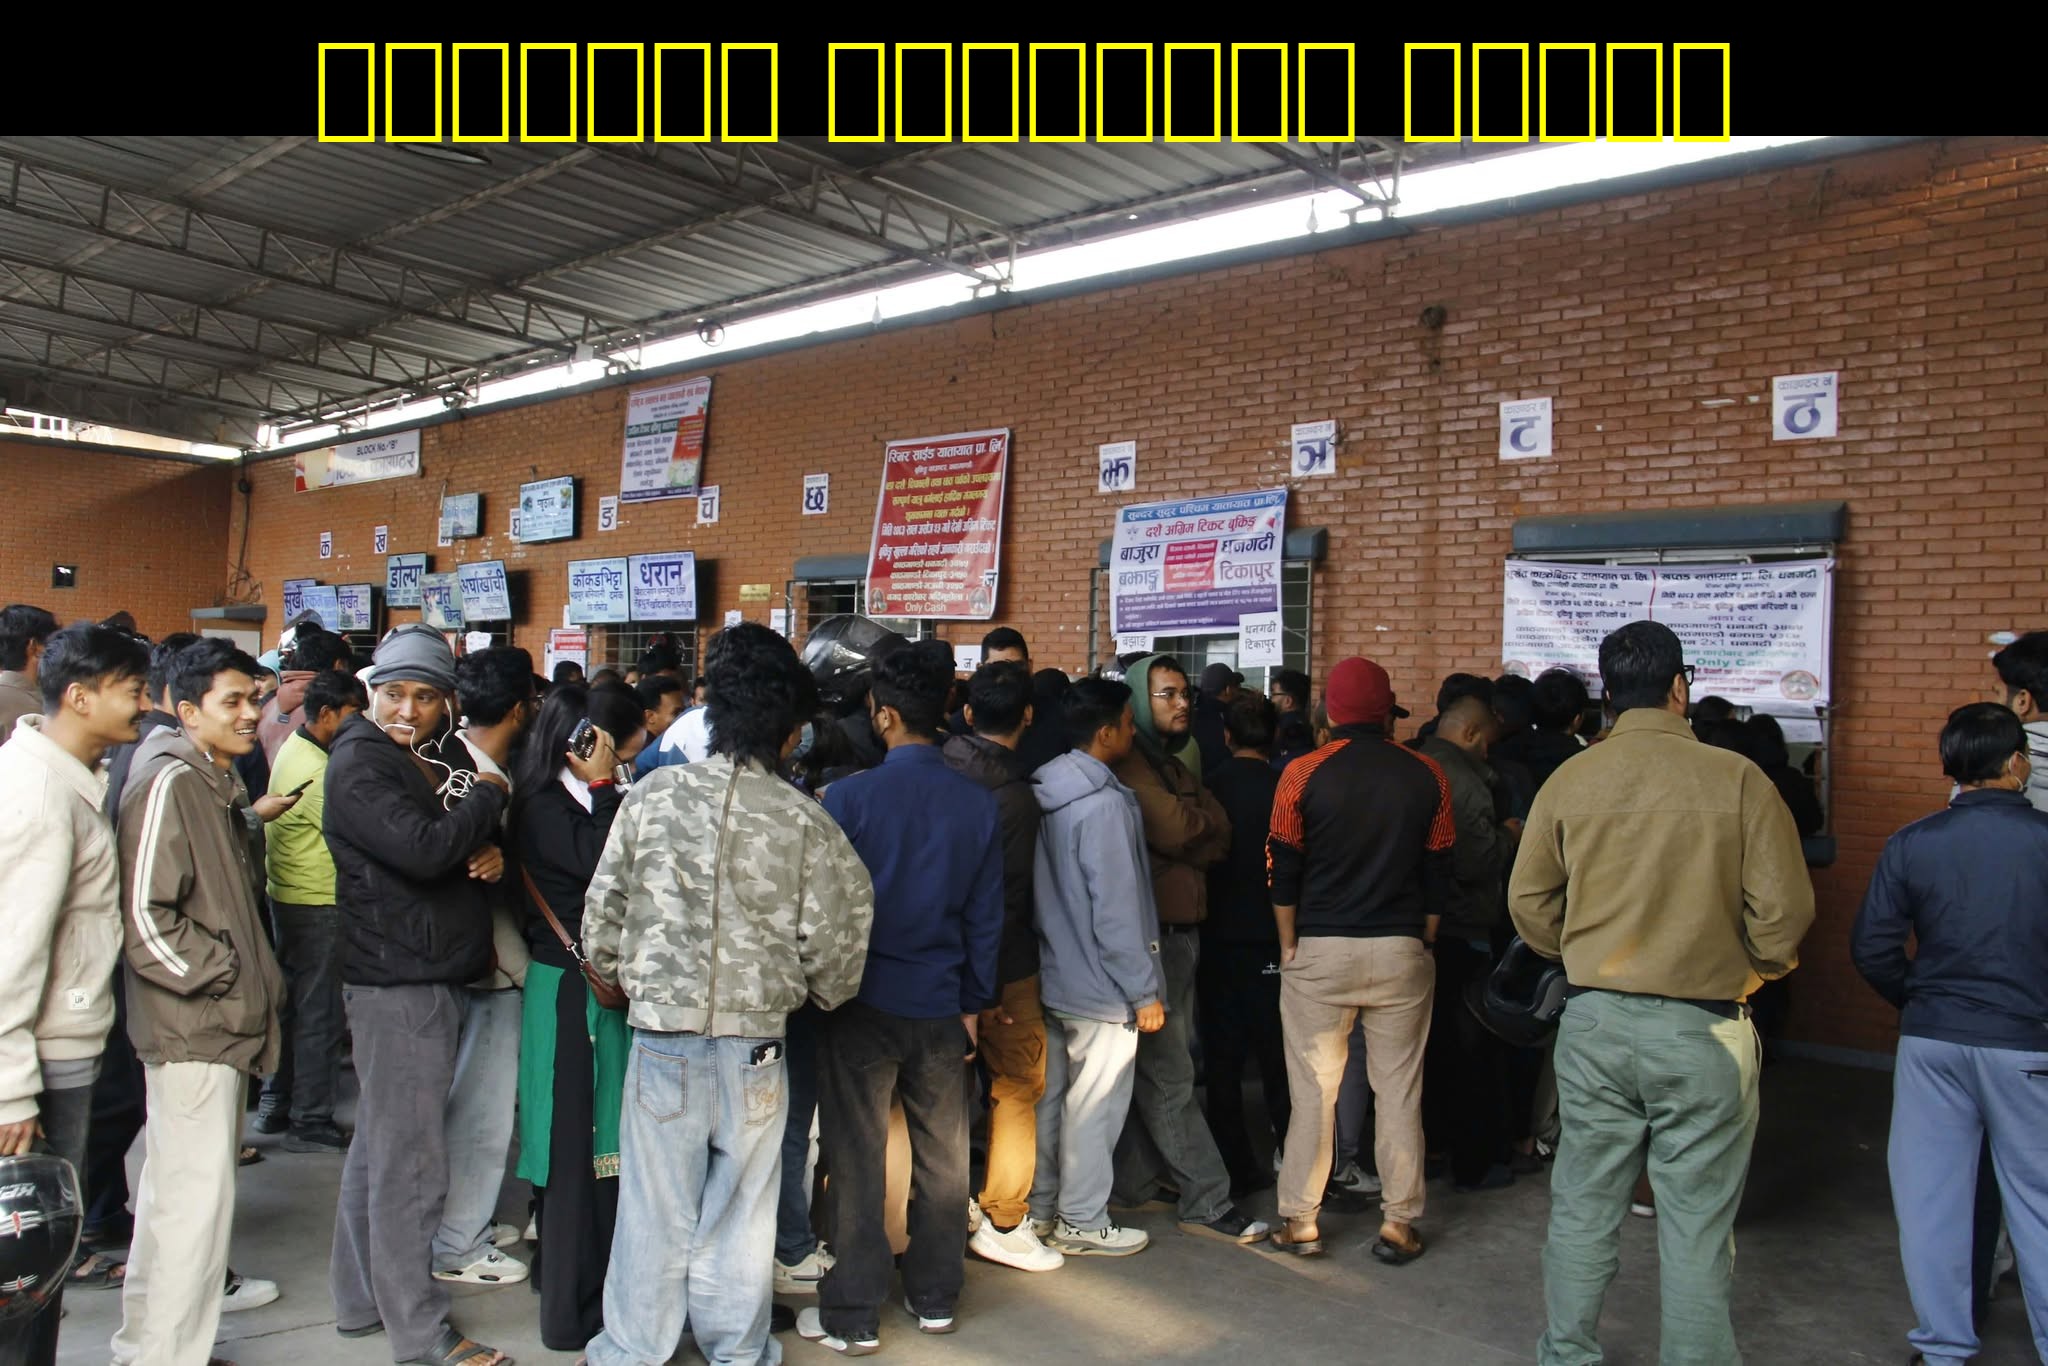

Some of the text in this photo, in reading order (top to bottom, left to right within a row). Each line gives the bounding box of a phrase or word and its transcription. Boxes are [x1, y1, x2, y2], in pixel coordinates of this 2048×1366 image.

[1783, 391, 1827, 434] ठ
[1510, 415, 1541, 452] ट
[356, 443, 377, 456] BLOCK
[702, 496, 715, 520] च
[805, 485, 827, 512] छ
[1211, 498, 1252, 512] यातायात
[602, 506, 614, 529] ङ
[1197, 517, 1225, 533] टिकट
[321, 540, 330, 557] क
[376, 533, 387, 553] ख
[1120, 543, 1161, 564] बाजुरा
[640, 560, 684, 588] धरान
[1220, 560, 1275, 582] टिकापुर
[905, 601, 946, 613] Only Cash
[1245, 620, 1277, 635] धनगढी
[1245, 638, 1275, 654] टिकापुर
[1696, 657, 1730, 668] Only
